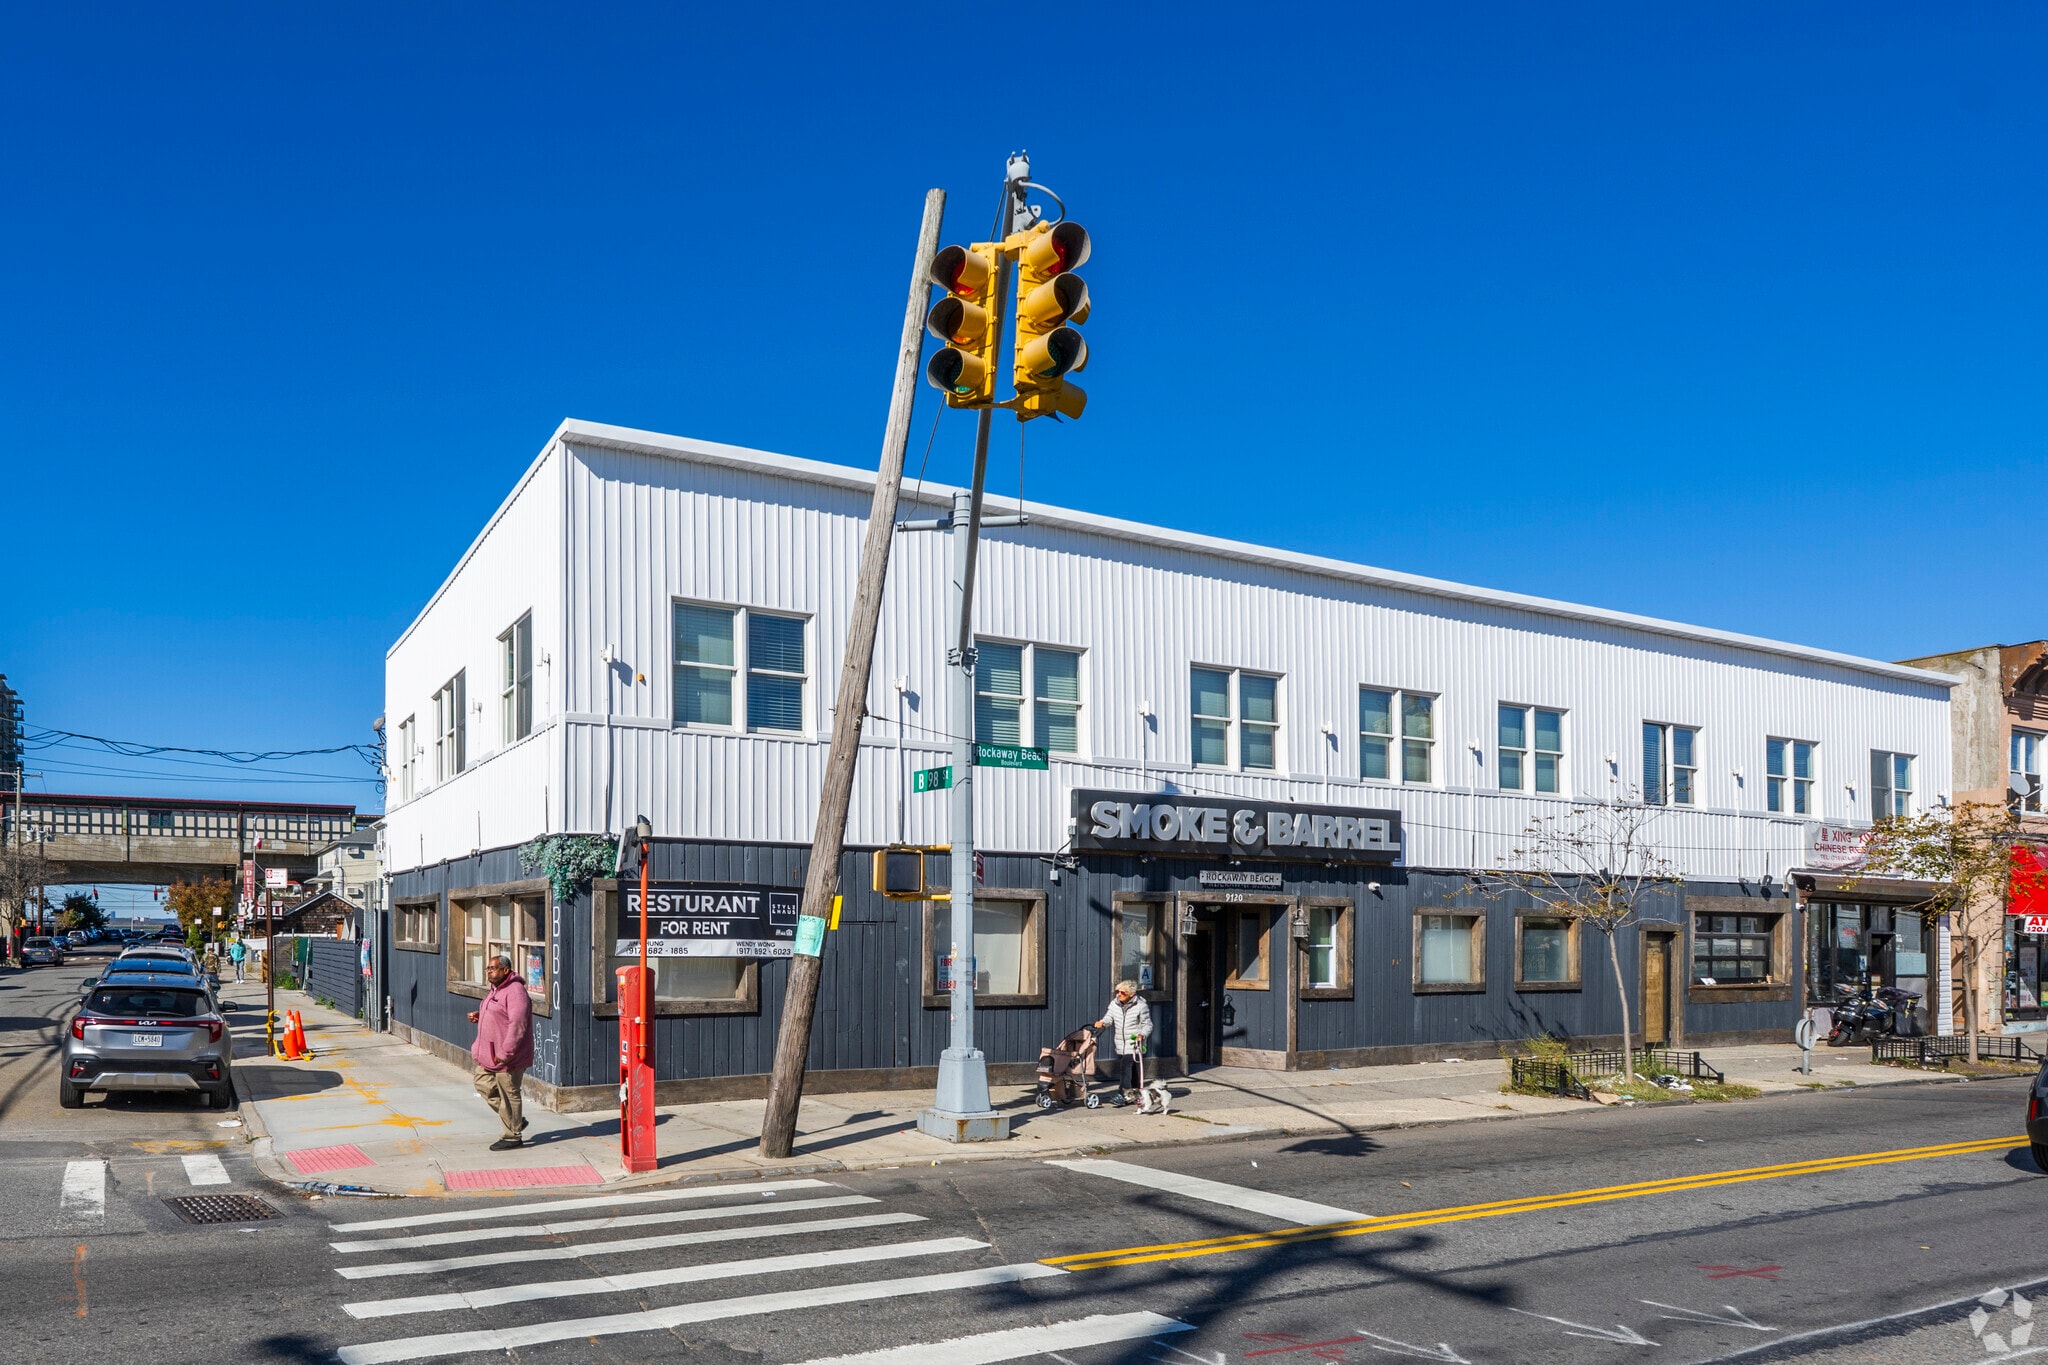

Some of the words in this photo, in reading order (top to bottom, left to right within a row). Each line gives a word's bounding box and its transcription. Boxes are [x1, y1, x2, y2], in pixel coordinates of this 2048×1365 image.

[976, 745, 1018, 761] Rockaway
[1021, 748, 1047, 761] Beach
[918, 773, 925, 790] B
[928, 771, 939, 788] 98
[942, 769, 949, 780] St
[1090, 800, 1229, 843] SMOKE
[1232, 809, 1266, 846] &
[1267, 811, 1401, 851] BARREL
[1832, 829, 1852, 843] XING
[1813, 842, 1847, 853] CHINESE
[1206, 872, 1248, 883] ROCKAWAY
[1250, 874, 1275, 883] BEACH
[627, 894, 760, 913] RESTURANT
[1225, 893, 1243, 902] 9120
[257, 906, 283, 916] DLI
[660, 921, 688, 935] FOR
[692, 921, 730, 935] RENT
[671, 947, 689, 955] 1885
[772, 948, 791, 956] 6023
[1141, 967, 1150, 980] A
